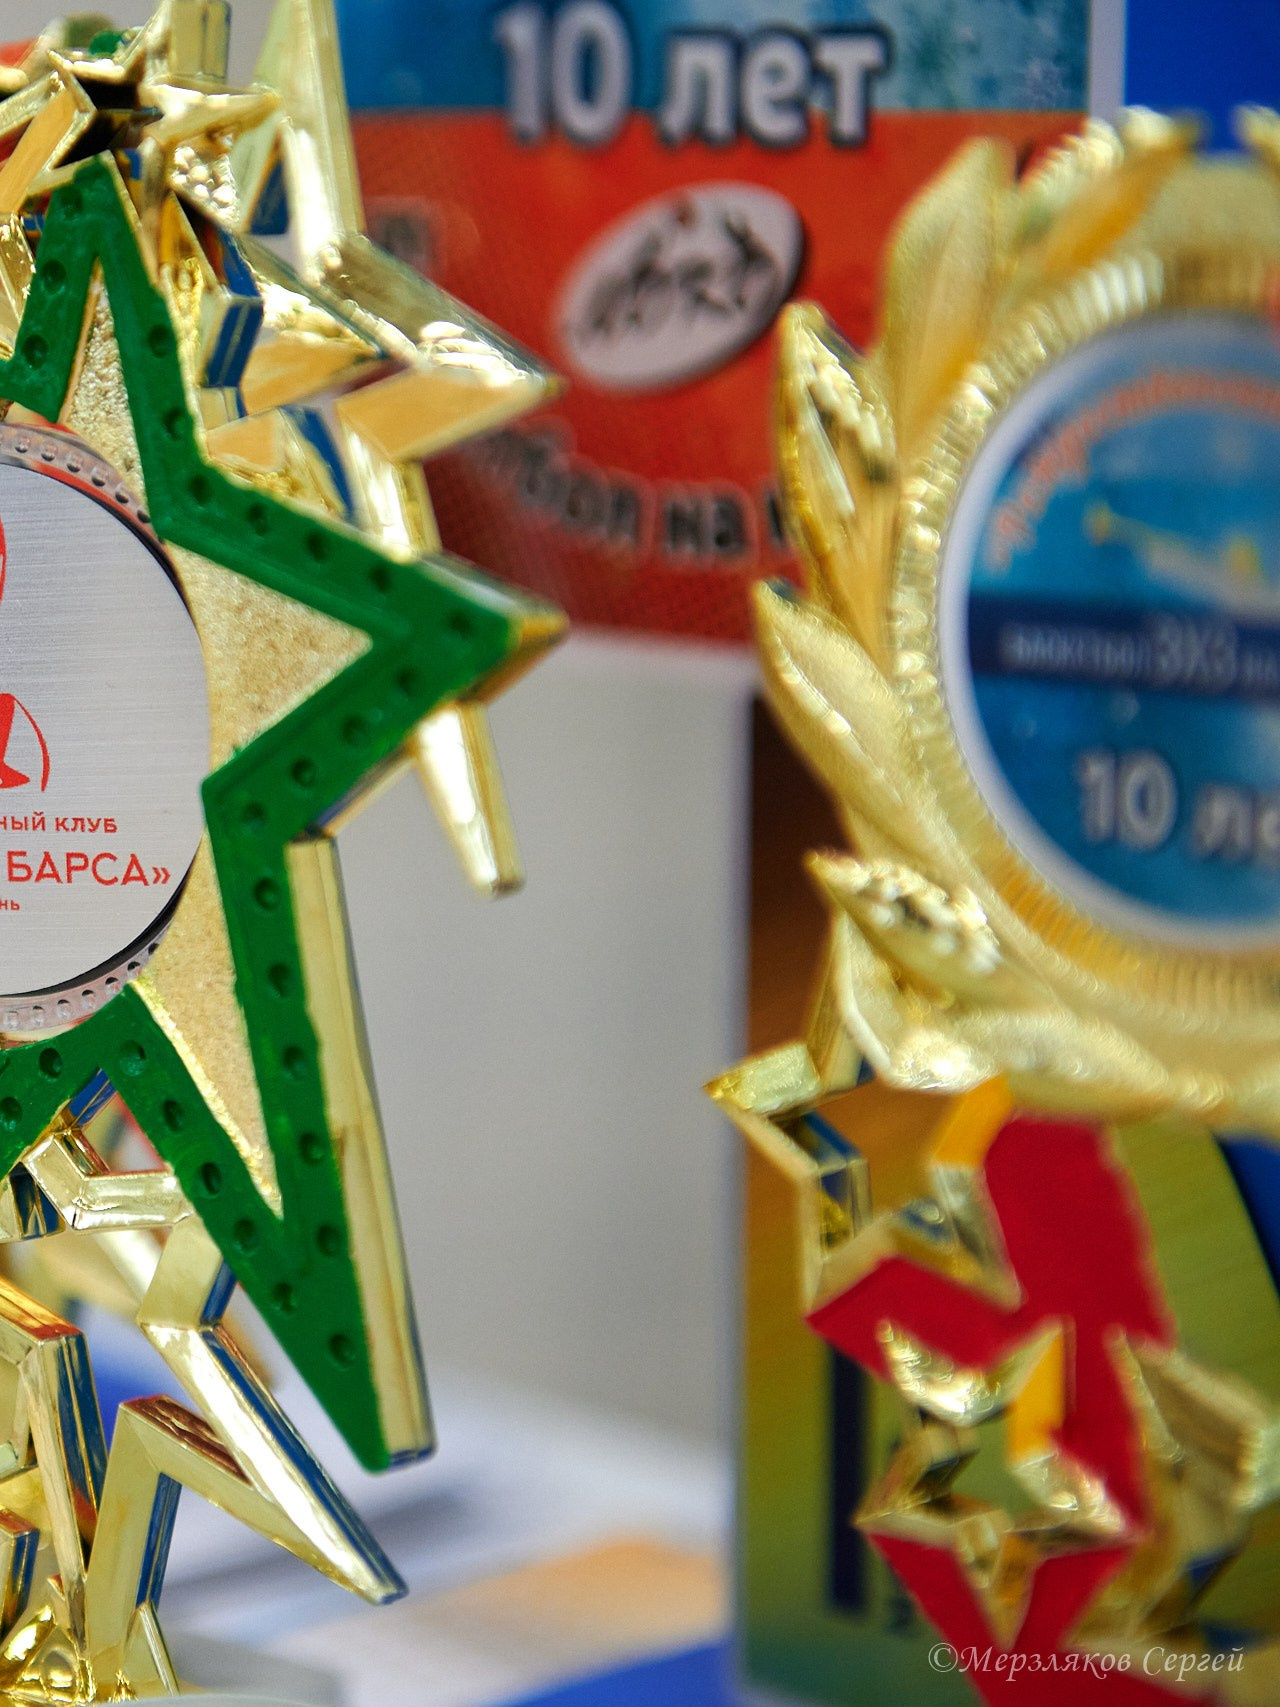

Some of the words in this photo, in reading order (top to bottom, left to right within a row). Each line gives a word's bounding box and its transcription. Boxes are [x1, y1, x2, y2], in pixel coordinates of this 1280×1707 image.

[498, 2, 632, 142] 10
[658, 32, 886, 142] лет
[54, 816, 118, 833] КЛУБ
[1076, 750, 1177, 850] 10
[7, 851, 171, 887] БАРСА»
